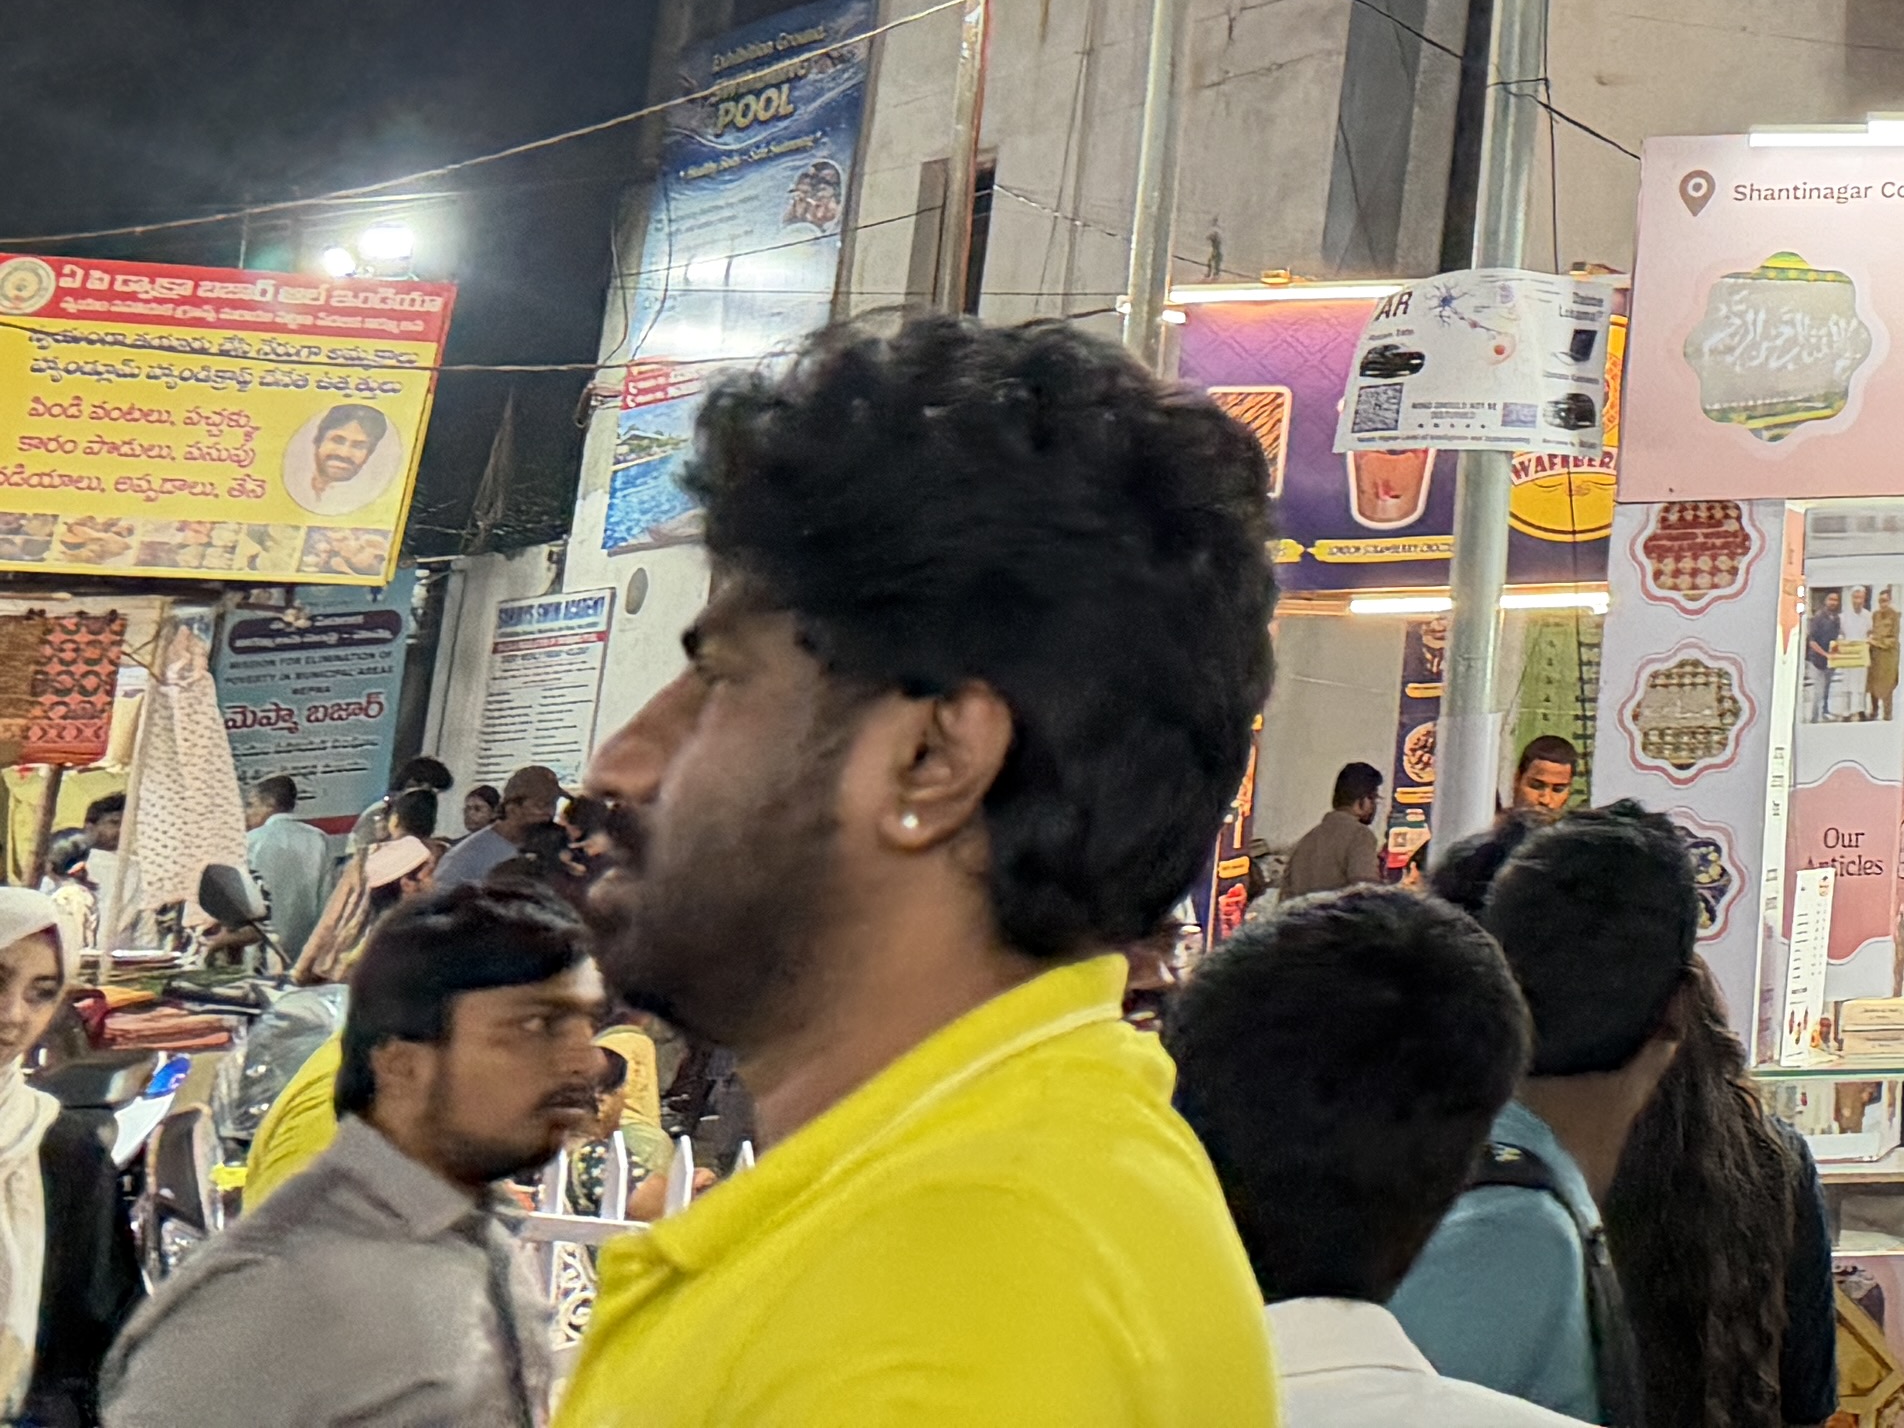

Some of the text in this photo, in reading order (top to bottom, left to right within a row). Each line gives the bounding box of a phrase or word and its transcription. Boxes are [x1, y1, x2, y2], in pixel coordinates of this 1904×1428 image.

[714, 83, 795, 139] POOL
[1733, 181, 1873, 204] Shantinagar
[17, 434, 78, 455] కారం
[224, 691, 385, 735] మెప్మా బజార్
[1823, 827, 1865, 849] Our
